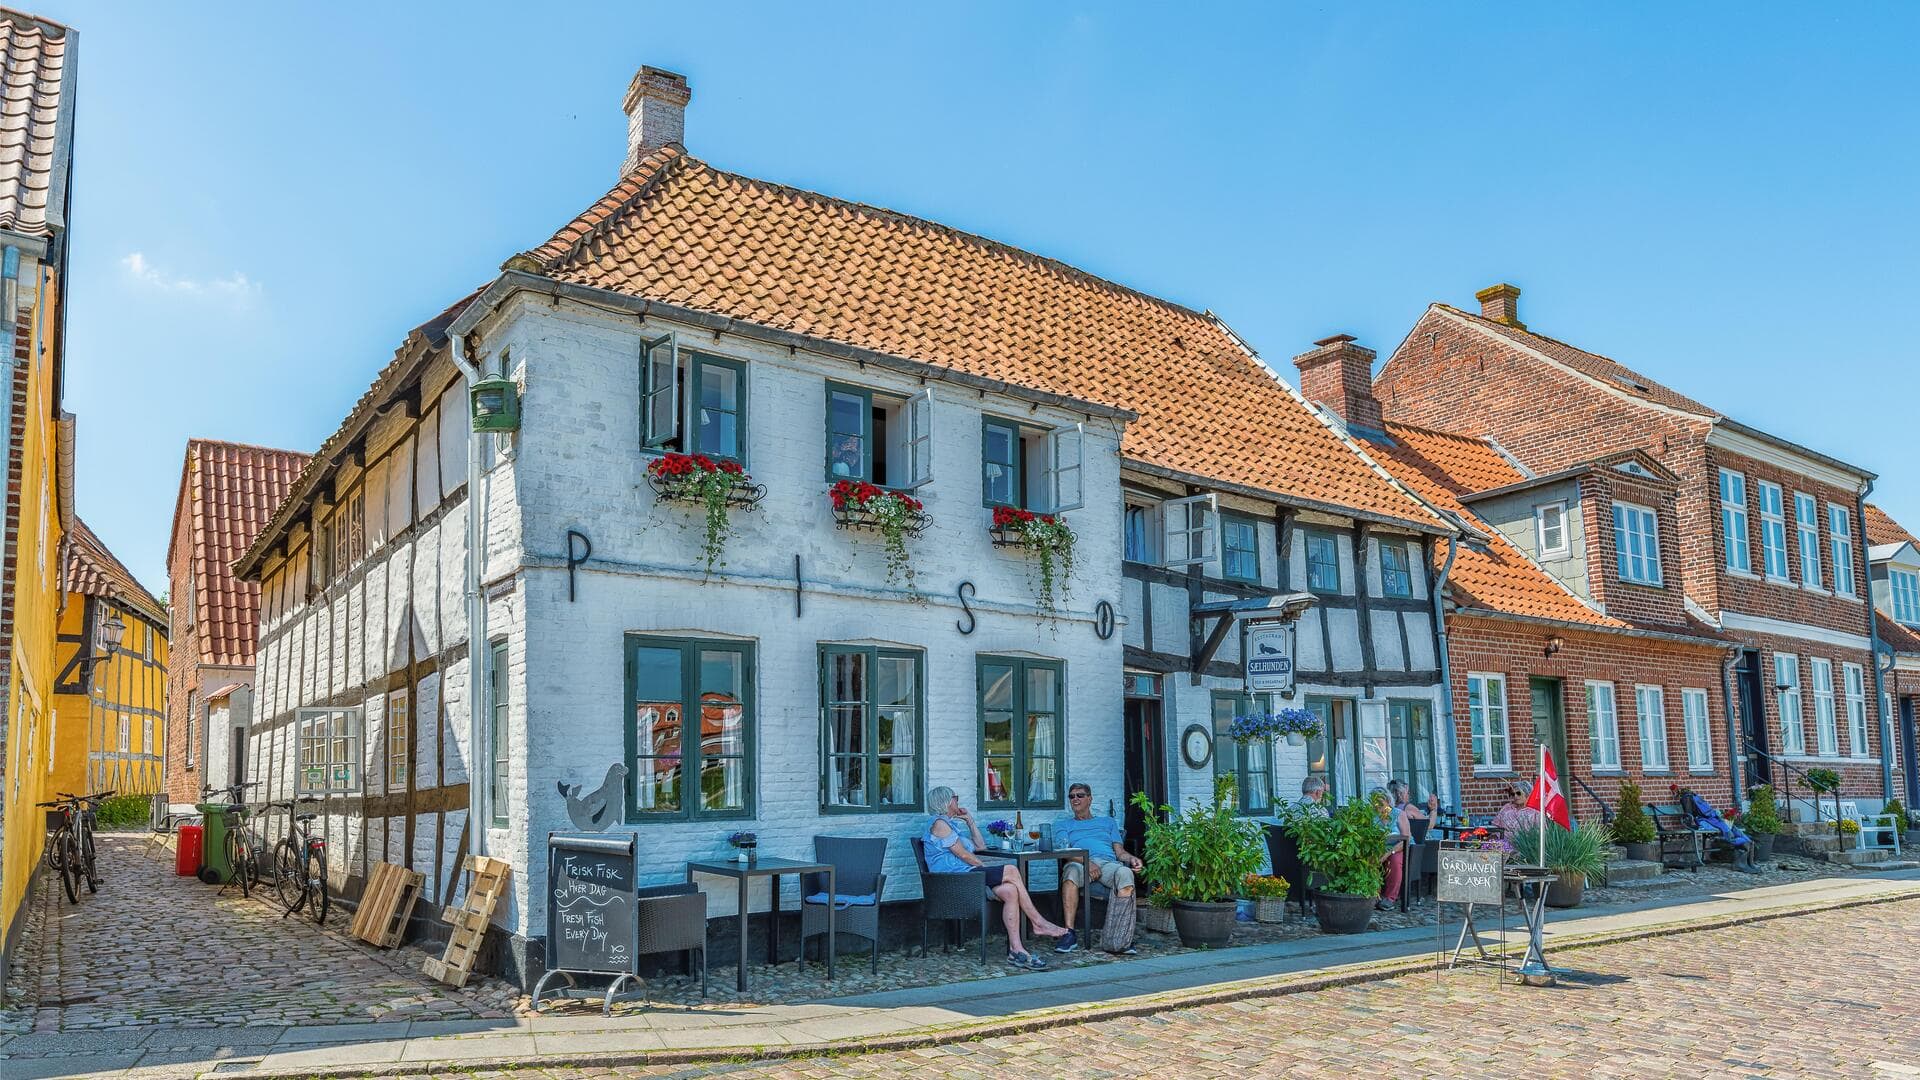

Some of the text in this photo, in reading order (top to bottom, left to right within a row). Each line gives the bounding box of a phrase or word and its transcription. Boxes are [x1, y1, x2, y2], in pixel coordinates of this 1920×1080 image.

[1250, 661, 1289, 672] SÆLHUNDEN
[564, 856, 623, 880] FRISK FISK
[1448, 874, 1463, 886] ER
[589, 883, 607, 896] DAG
[558, 908, 604, 926] FRESH FISH
[565, 926, 608, 952] EVERY DAY
